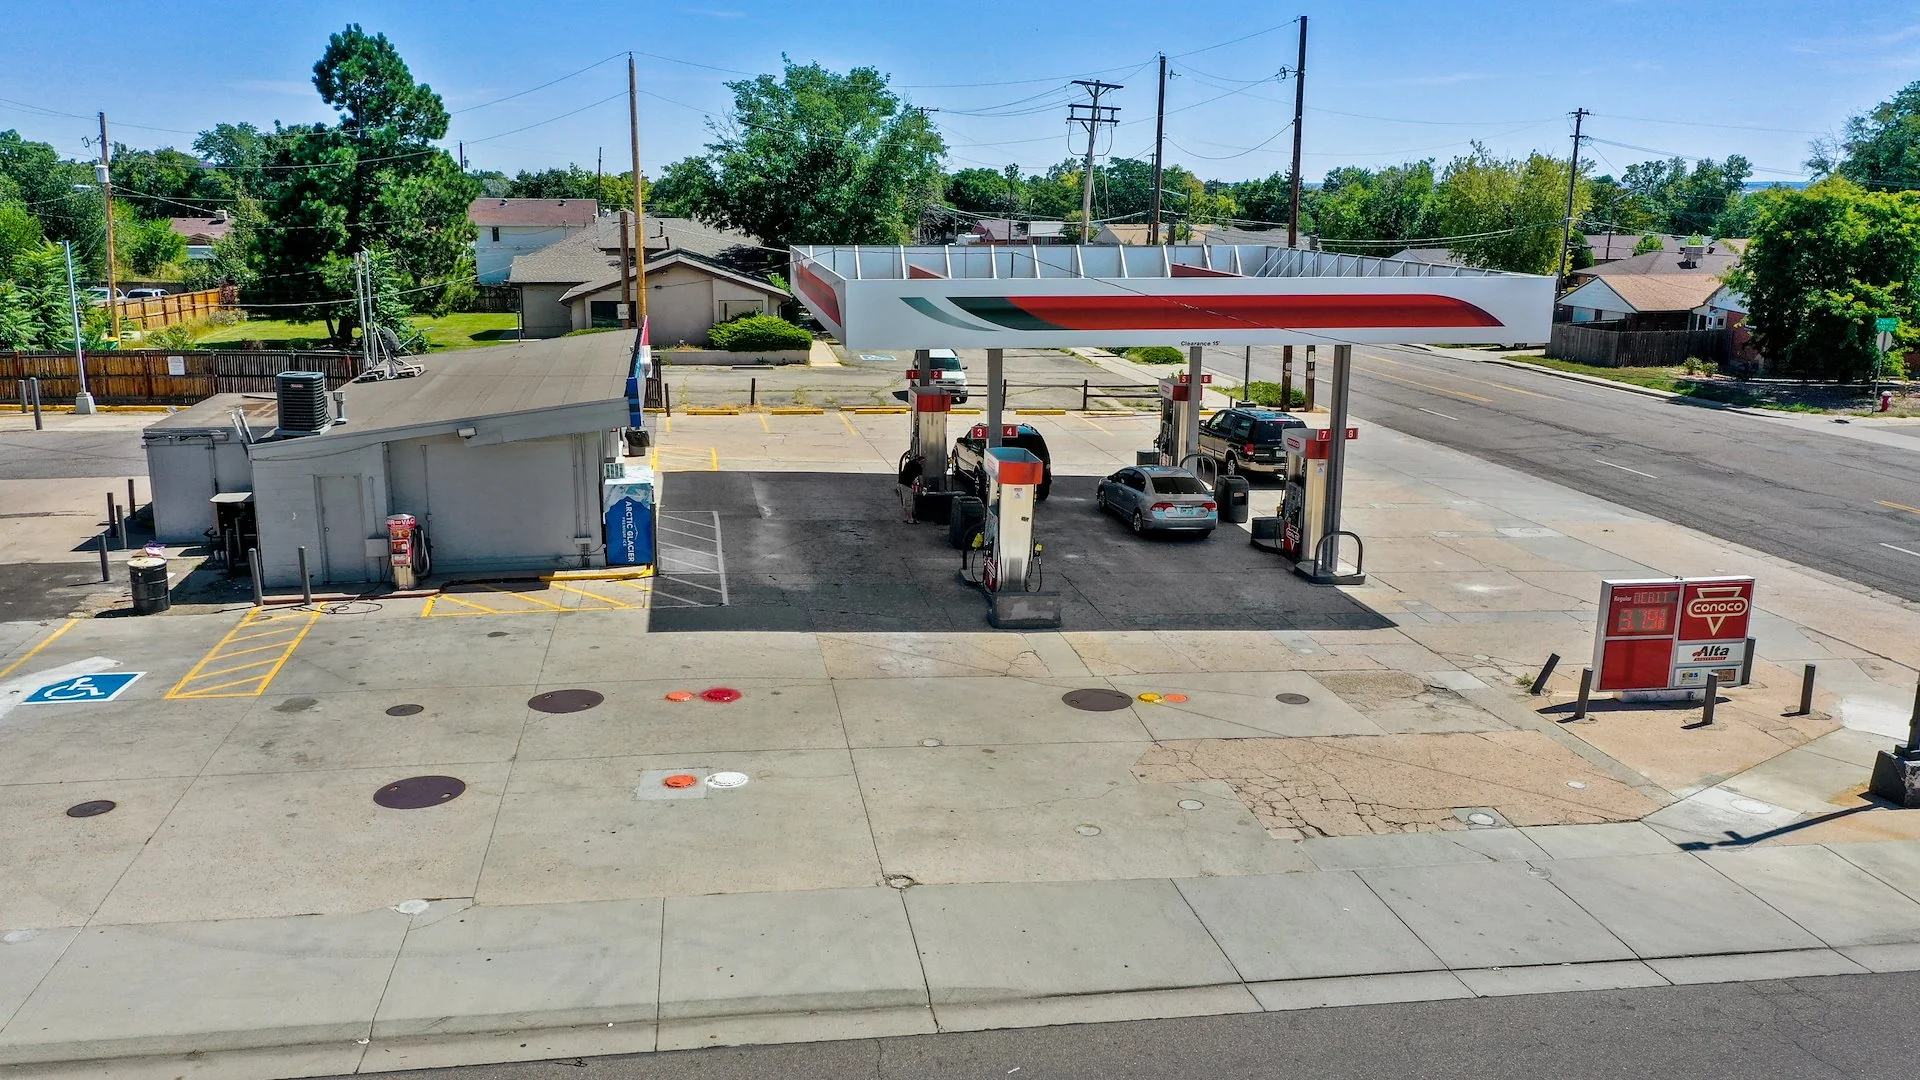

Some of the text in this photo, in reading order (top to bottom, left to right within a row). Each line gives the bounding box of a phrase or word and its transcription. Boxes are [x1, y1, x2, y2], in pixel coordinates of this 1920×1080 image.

[977, 428, 982, 437] 3
[1006, 427, 1012, 436] 4
[625, 501, 635, 562] ARCTIC GLACIER
[1633, 591, 1669, 604] DEBIT
[1693, 645, 1730, 657] Alta
